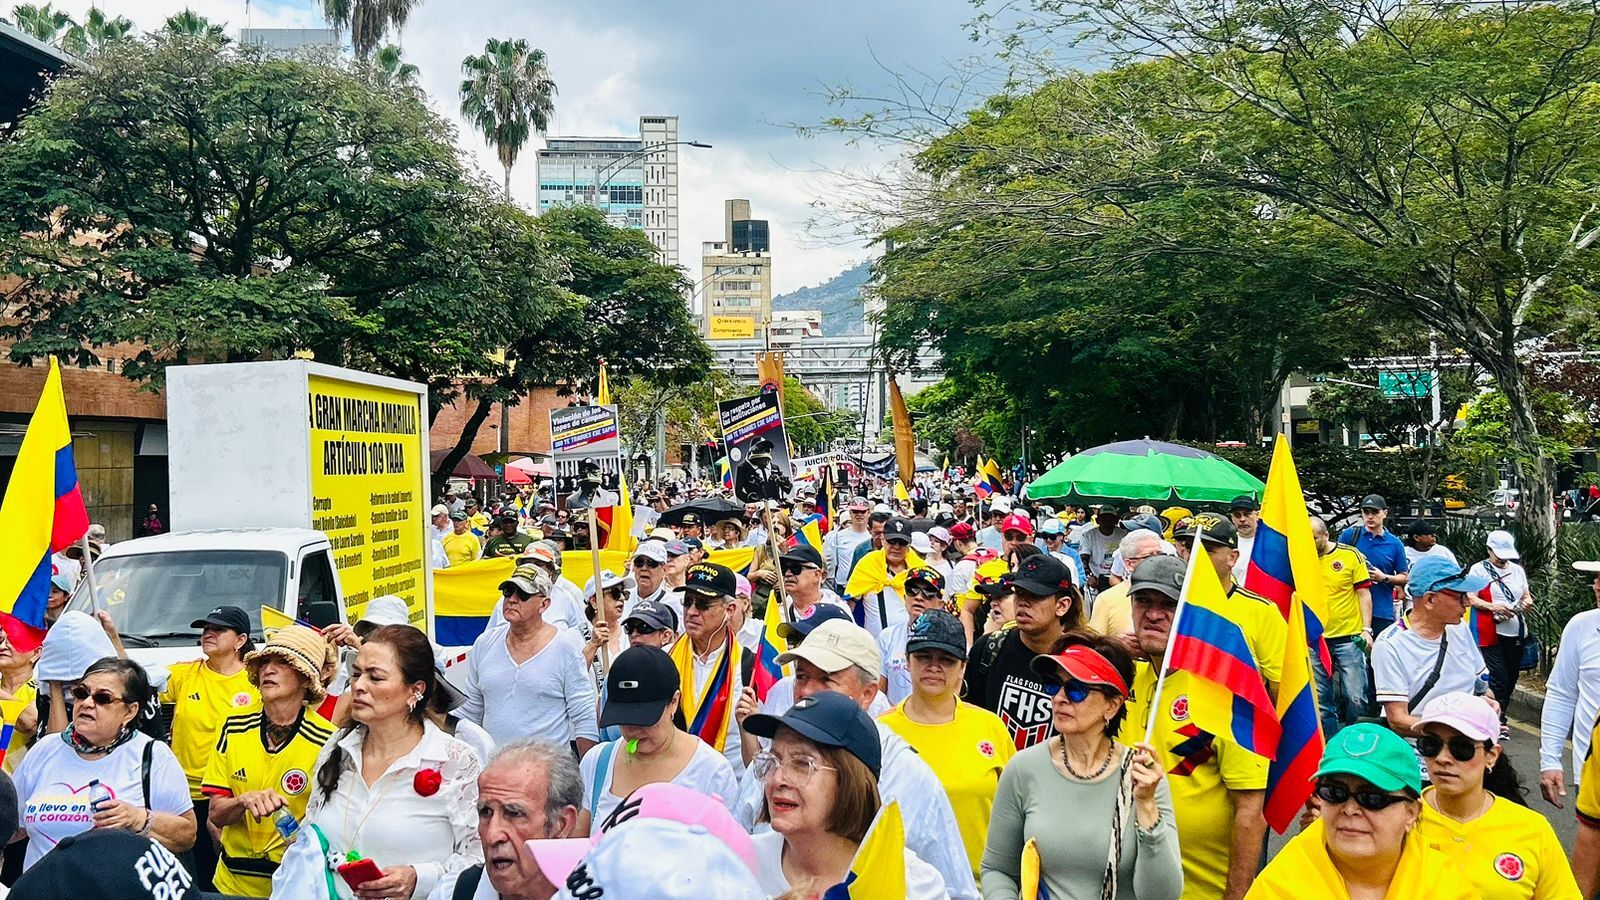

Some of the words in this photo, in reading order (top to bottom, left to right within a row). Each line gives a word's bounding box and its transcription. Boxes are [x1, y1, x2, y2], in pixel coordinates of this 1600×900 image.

[315, 393, 342, 431] GRAN
[344, 397, 380, 433] MARCHA
[381, 402, 416, 435] AMARILLA
[552, 411, 581, 425] Violación
[582, 409, 591, 417] de
[591, 407, 601, 415] los
[721, 411, 730, 419] Sin
[730, 401, 750, 414] respeto
[750, 396, 761, 407] por
[722, 418, 731, 426] las
[730, 402, 767, 422] instituciones
[553, 421, 571, 432] topes
[571, 419, 580, 427] de
[580, 411, 610, 425] campaña
[323, 434, 368, 475] ARTÍCULO
[368, 442, 384, 475] 109
[384, 443, 405, 474] YAAA
[804, 456, 828, 467] JUICIO
[313, 496, 332, 511] Corrupto
[1006, 674, 1024, 686] FLAG
[1003, 687, 1052, 723] FHS
[39, 803, 67, 812] llevo
[71, 804, 86, 812] en
[25, 813, 37, 823] mi
